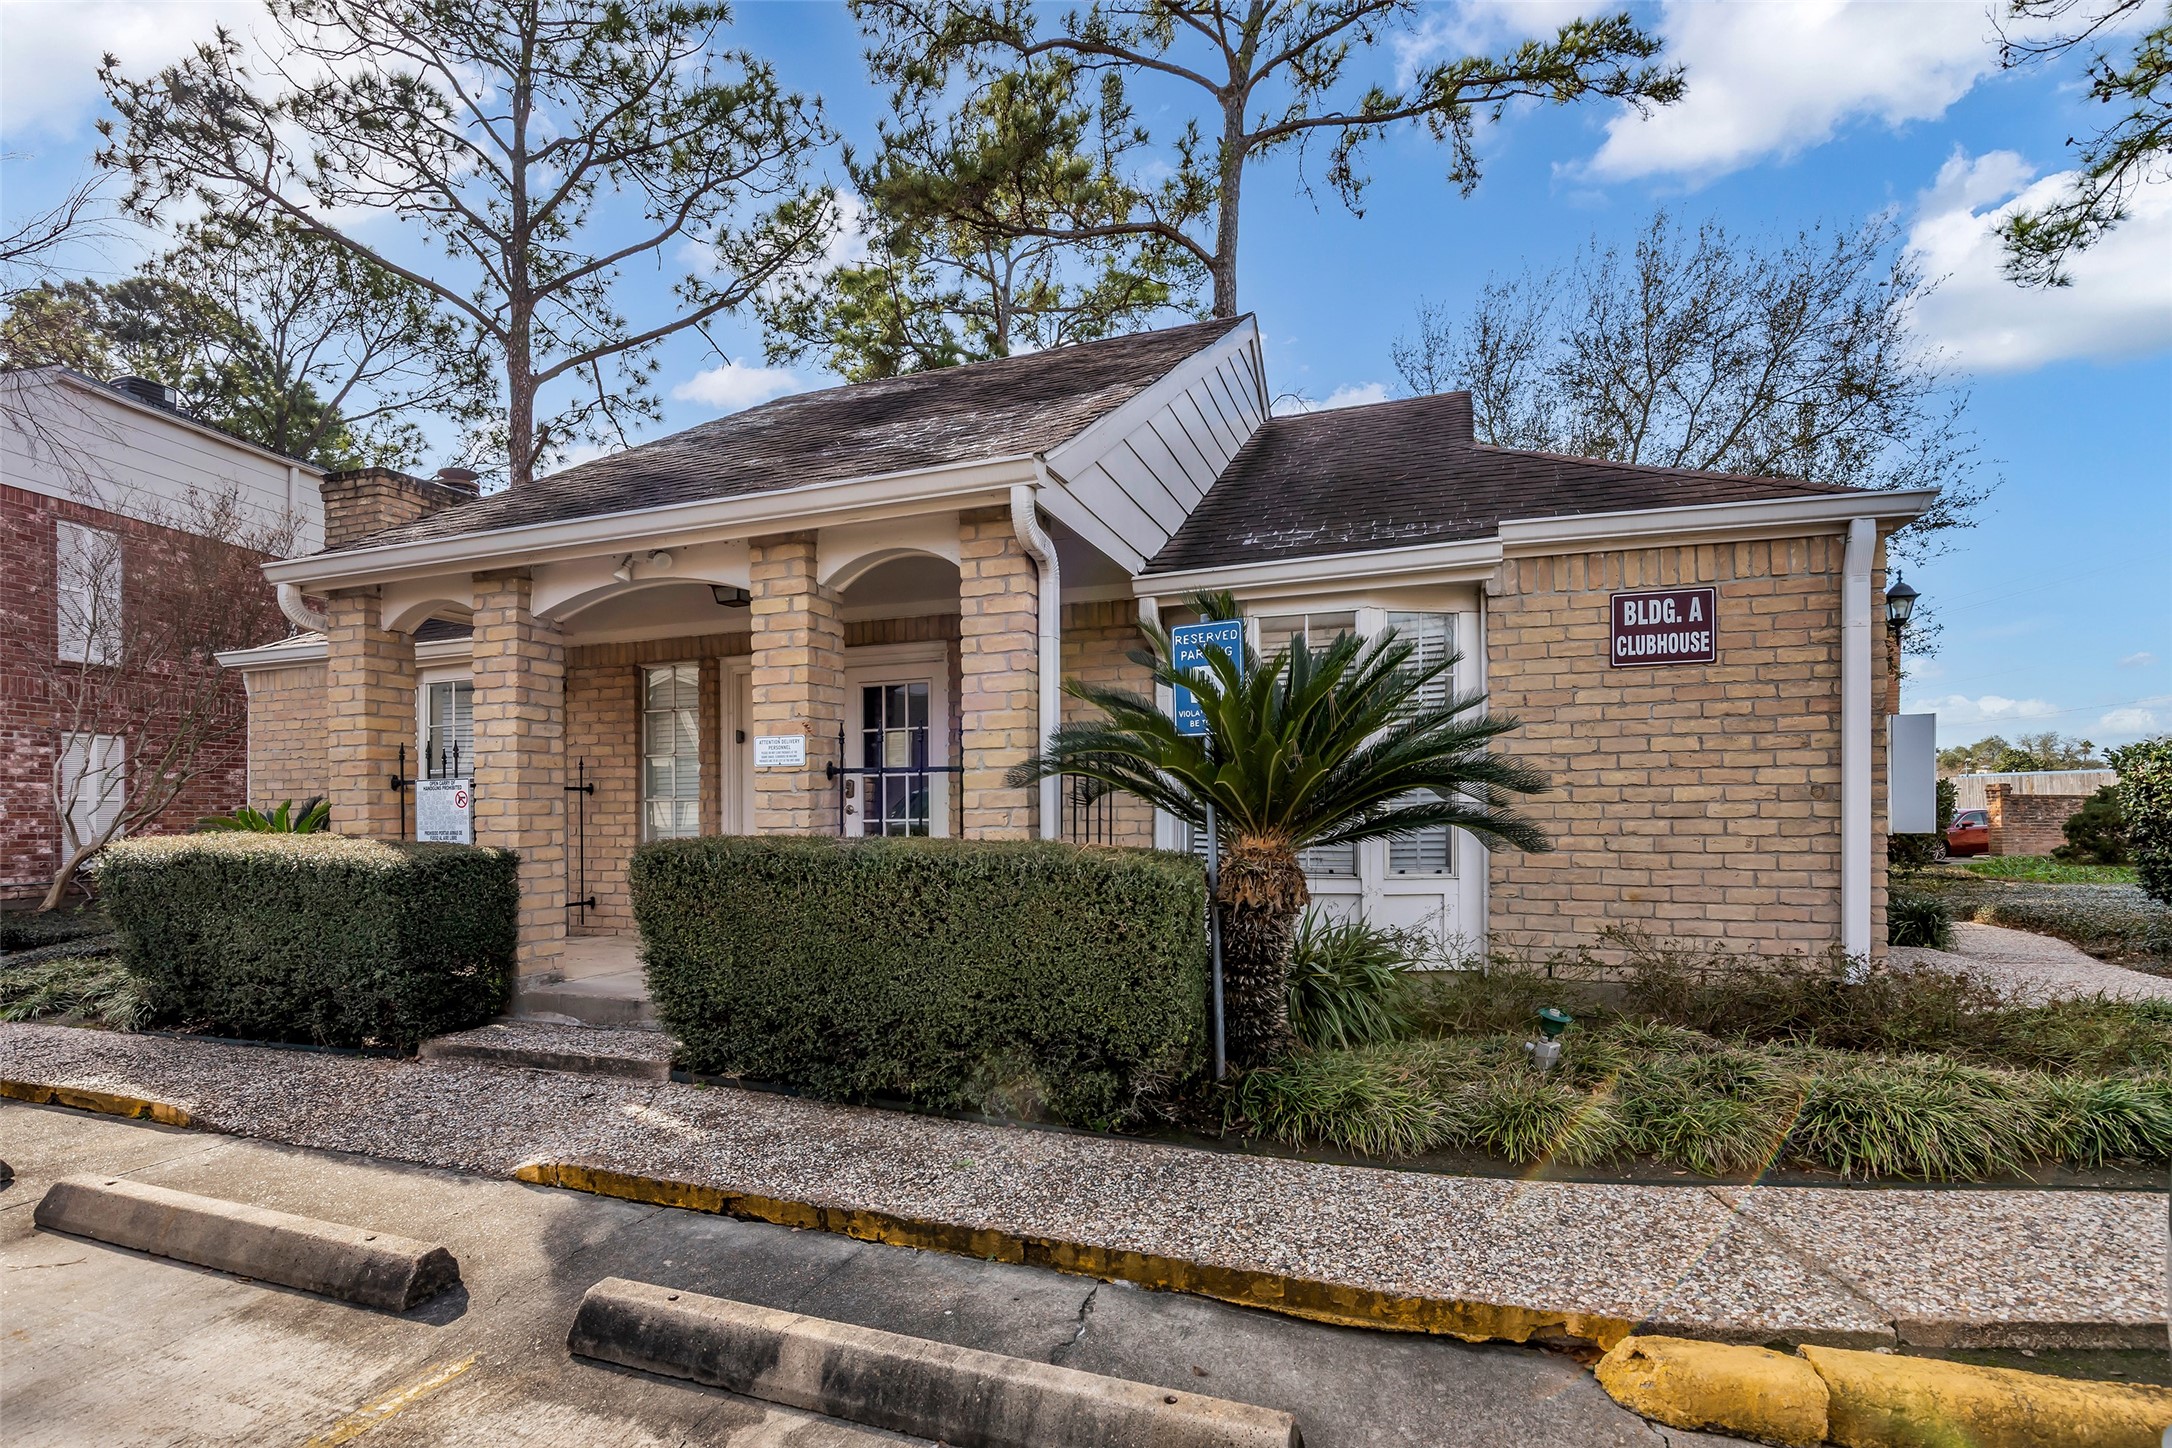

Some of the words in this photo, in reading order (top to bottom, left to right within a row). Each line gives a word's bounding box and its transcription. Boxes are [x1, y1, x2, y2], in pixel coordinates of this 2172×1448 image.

[1624, 598, 1682, 626] BLDG.
[1689, 597, 1703, 621] A
[1175, 629, 1238, 646] RESERVED
[1616, 631, 1710, 656] CLUBHOUSE
[1180, 646, 1233, 661] PARG
[1189, 719, 1200, 727] BE
